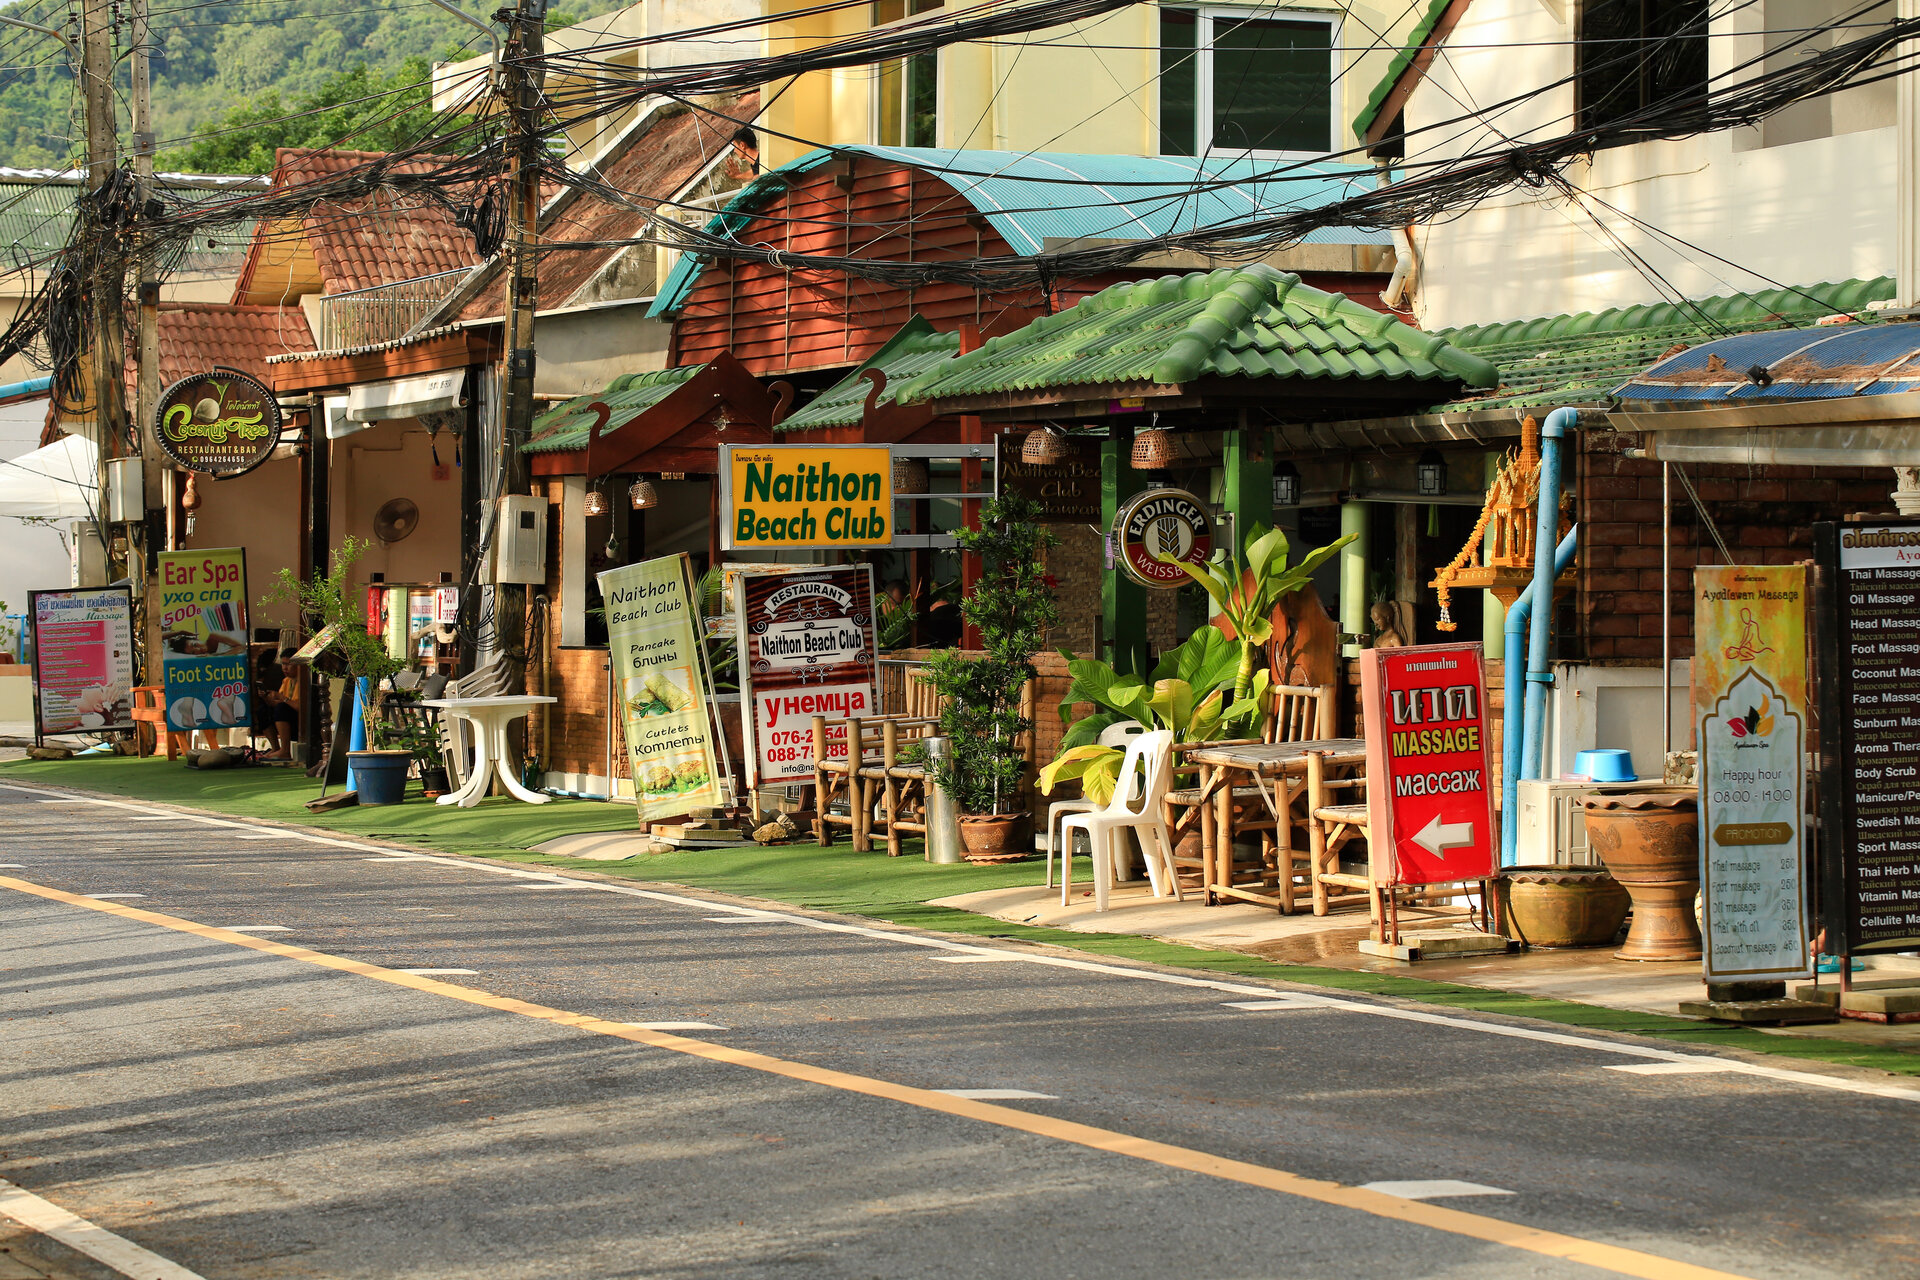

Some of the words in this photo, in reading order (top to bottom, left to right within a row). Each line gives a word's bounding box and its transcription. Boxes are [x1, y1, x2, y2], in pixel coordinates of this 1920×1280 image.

[163, 403, 227, 443] Coconut
[225, 412, 269, 440] Tree
[744, 461, 881, 502] Naithon
[1040, 480, 1082, 498] Club
[736, 507, 817, 541] Beach
[825, 506, 885, 539] Club
[1129, 499, 1205, 537] ERDINGER
[1137, 547, 1205, 578] WEISSBÄU
[165, 562, 197, 585] Ear
[203, 559, 239, 589] Spa
[1849, 570, 1872, 580] Thai
[1875, 569, 1920, 580] Massage
[163, 591, 194, 607] ухо
[200, 589, 232, 602] спа
[611, 581, 676, 606] Naithon
[770, 584, 845, 607] RESTAURANT
[1758, 589, 1799, 602] Massage
[1849, 594, 1864, 604] Oil
[1868, 594, 1915, 605] Massage
[82, 612, 125, 622] Massage
[612, 606, 648, 624] Beach
[655, 598, 681, 614] Club
[1850, 619, 1878, 629] Head
[630, 638, 676, 654] Pancake
[761, 633, 801, 657] Naithon
[804, 630, 836, 653] Beach
[838, 628, 862, 650] Club
[1851, 644, 1875, 654] Foot
[1879, 643, 1920, 654] Massag
[633, 651, 678, 668] блины
[1406, 657, 1458, 672] นวดแผนไทย
[169, 667, 202, 684] Foot
[205, 662, 245, 681] Scrub
[1852, 668, 1896, 679] Coconut
[1390, 684, 1478, 725] นวด
[1852, 694, 1879, 704] Face
[1853, 718, 1897, 729] Sunburn
[645, 724, 689, 739] Cutlets
[634, 734, 705, 756] Котлеты
[1392, 726, 1481, 757] MASSAGE
[1854, 743, 1889, 754] Aroma
[1723, 769, 1755, 784] Happy
[1758, 768, 1781, 780] hour
[1855, 768, 1882, 779] Body
[1885, 766, 1916, 777] Scrub
[1395, 769, 1482, 797] массаж
[1856, 816, 1901, 828] Swedish
[1725, 828, 1781, 840] PROMOTION
[1857, 842, 1886, 854] Sport
[1712, 859, 1728, 872] Thai
[1730, 862, 1760, 873] massage
[1780, 858, 1795, 870] 250
[1858, 866, 1881, 877] Thai
[1884, 865, 1910, 876] Herb
[1730, 882, 1761, 894] massage
[1780, 879, 1796, 890] 250
[1859, 890, 1898, 902] Vitamin
[1725, 903, 1757, 915] massage
[1781, 899, 1796, 910] 350
[1782, 919, 1797, 931] 350
[1860, 915, 1902, 927] Cellulite
[1714, 943, 1744, 955] Coconut
[1745, 943, 1776, 955] massage
